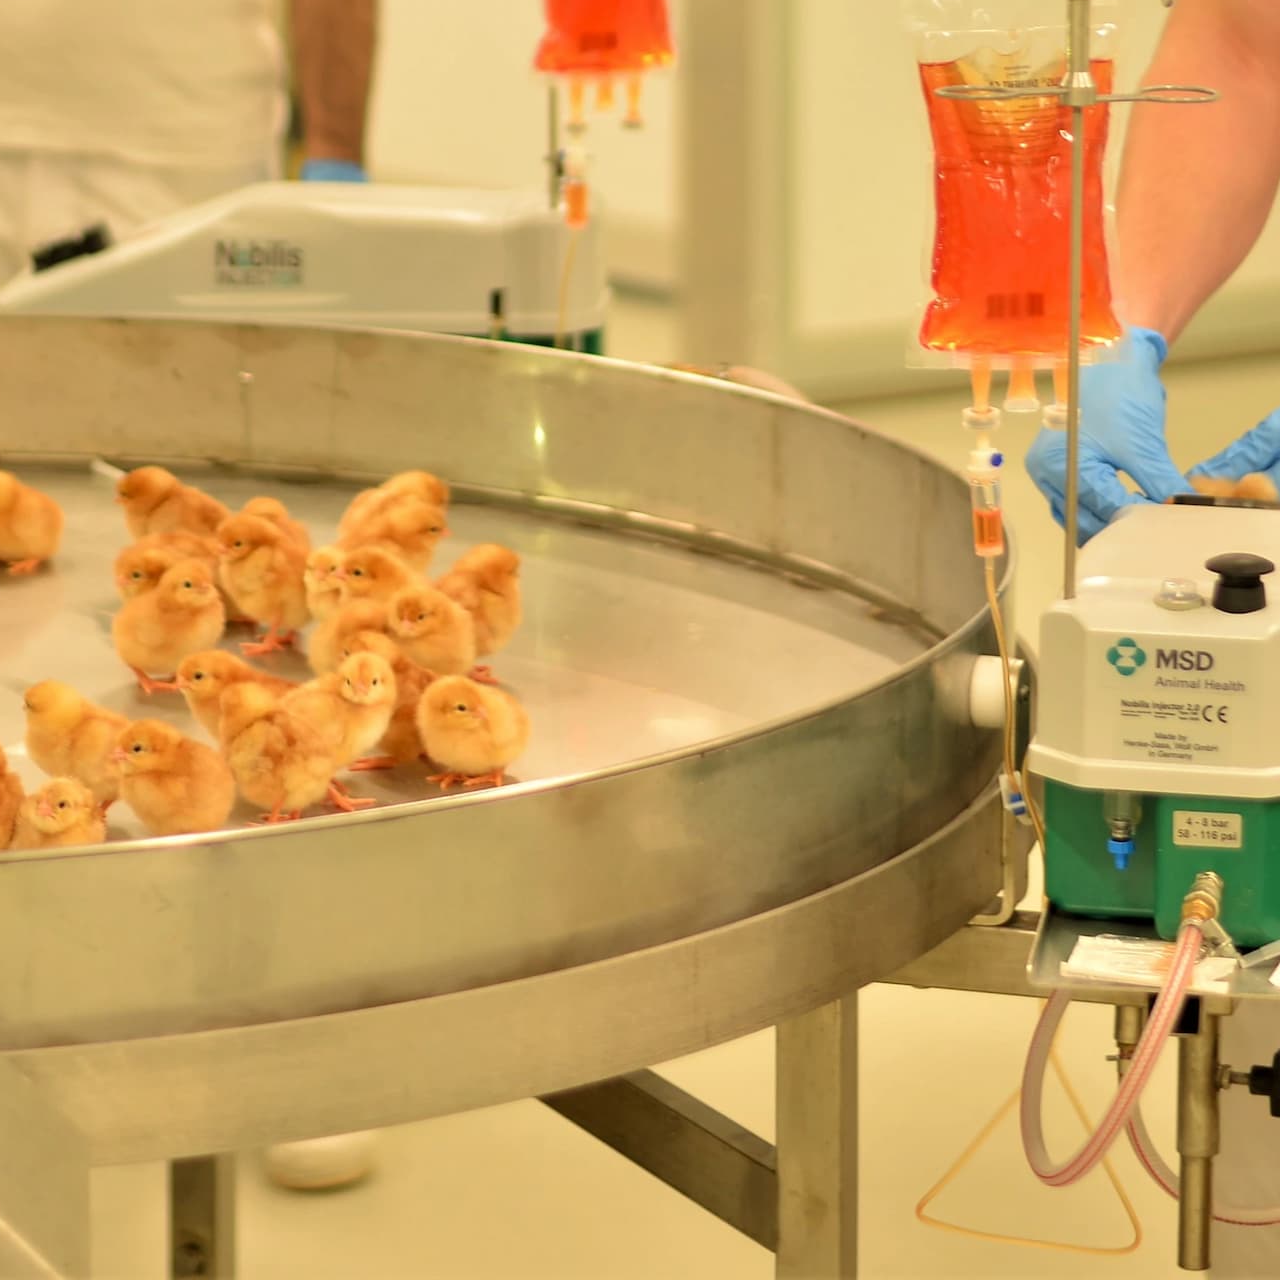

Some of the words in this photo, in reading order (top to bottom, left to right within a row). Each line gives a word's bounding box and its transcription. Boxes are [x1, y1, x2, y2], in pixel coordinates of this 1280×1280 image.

[215, 240, 304, 267] Nobilis
[1156, 649, 1214, 671] MSD
[1154, 677, 1201, 689] Animal
[1204, 679, 1245, 692] Health
[1211, 818, 1229, 828] bar
